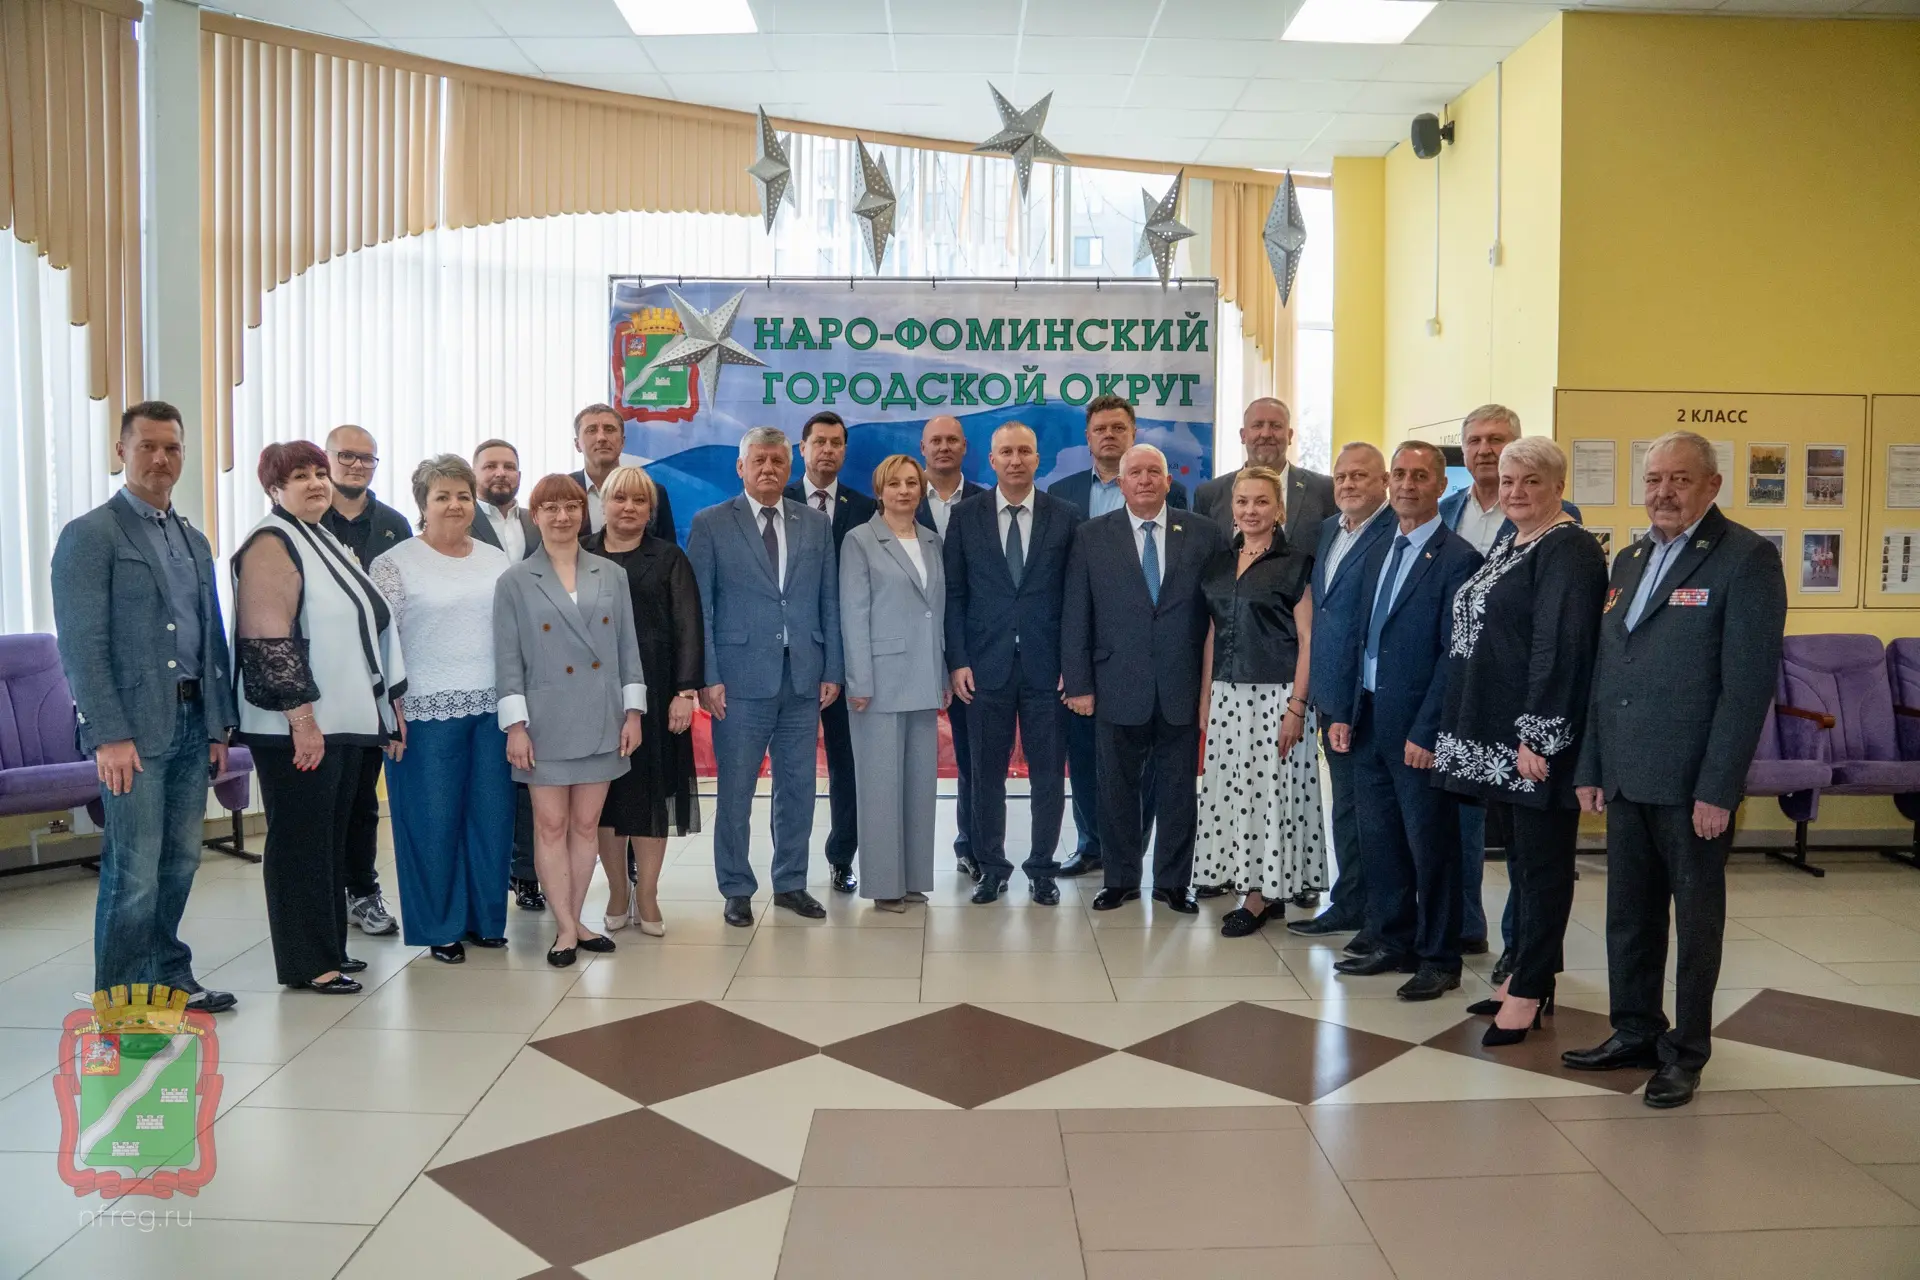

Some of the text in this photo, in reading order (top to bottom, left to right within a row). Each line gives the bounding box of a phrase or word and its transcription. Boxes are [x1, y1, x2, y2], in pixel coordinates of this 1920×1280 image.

[753, 311, 1209, 352] НАРО-ФОМИНСКИЙ
[762, 365, 1200, 411] ГОРОДСКОЙ ОКРУГ
[1677, 409, 1748, 423] 2 КЛАСС
